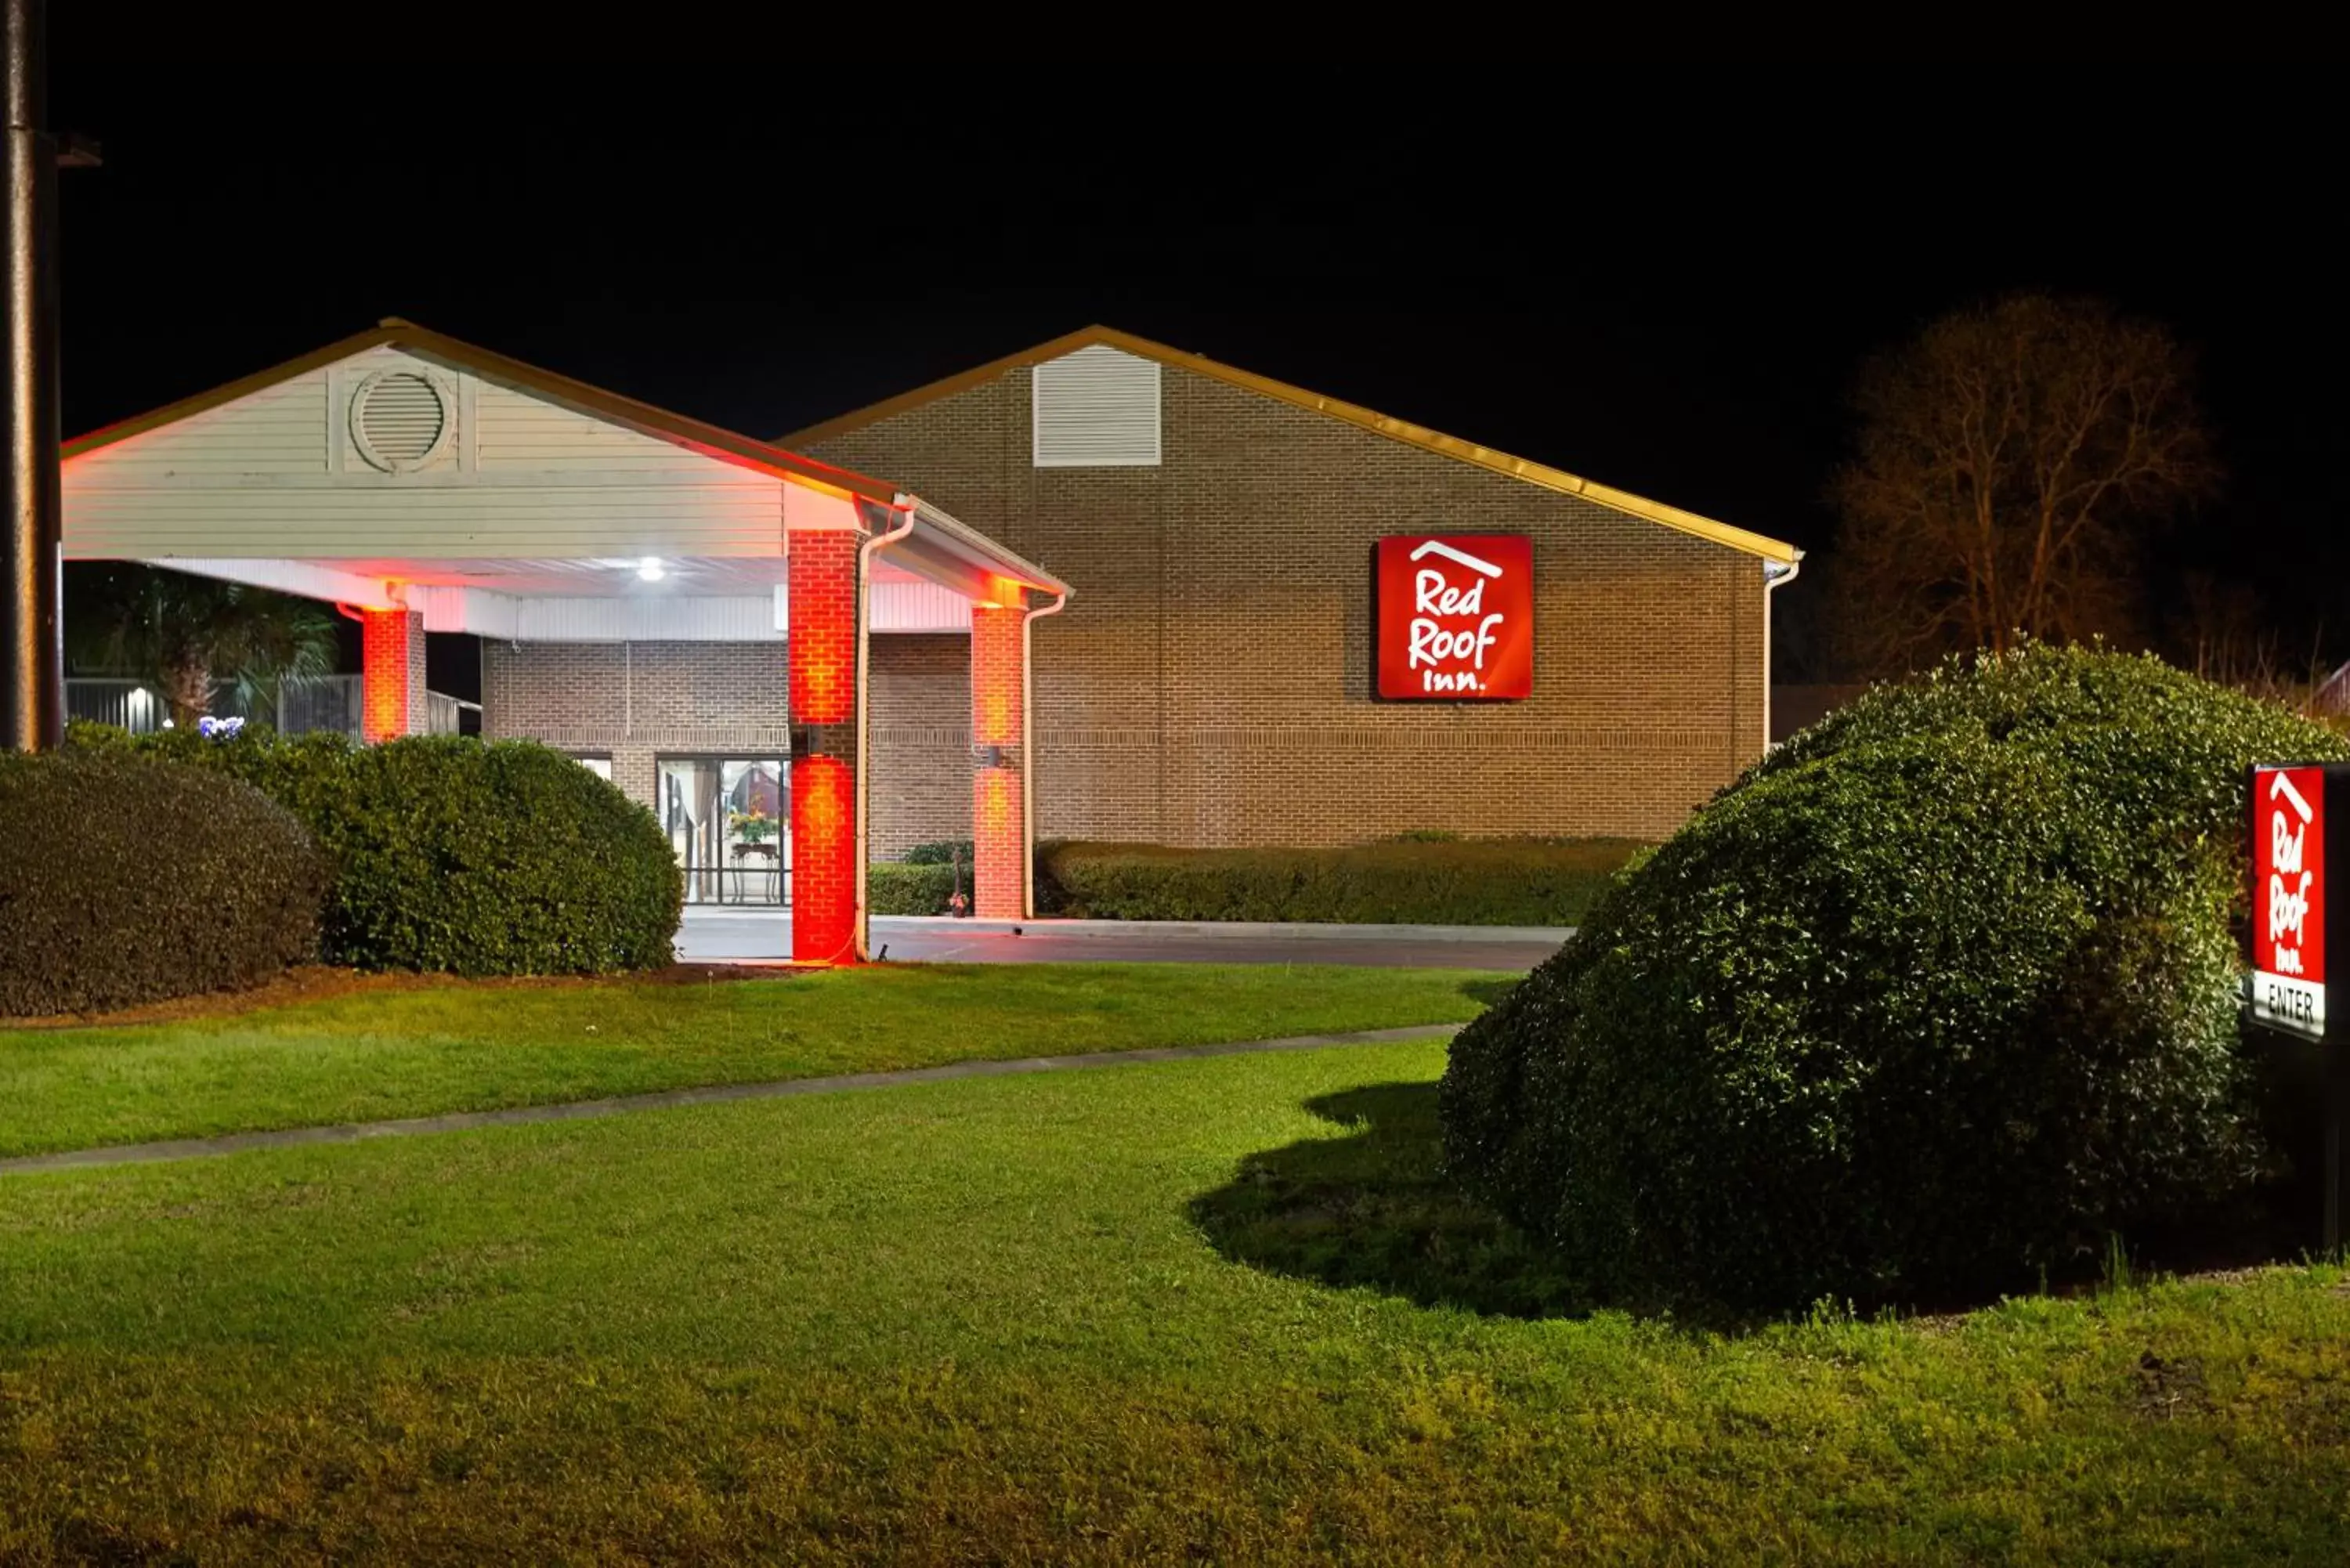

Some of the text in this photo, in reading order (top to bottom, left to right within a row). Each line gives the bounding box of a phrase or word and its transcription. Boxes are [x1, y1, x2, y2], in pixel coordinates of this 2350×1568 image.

[1416, 569, 1484, 616] Red
[1408, 613, 1504, 670] Roof
[2272, 810, 2305, 873] Red
[2269, 870, 2312, 946] Roof
[2269, 984, 2314, 1023] ENTER
